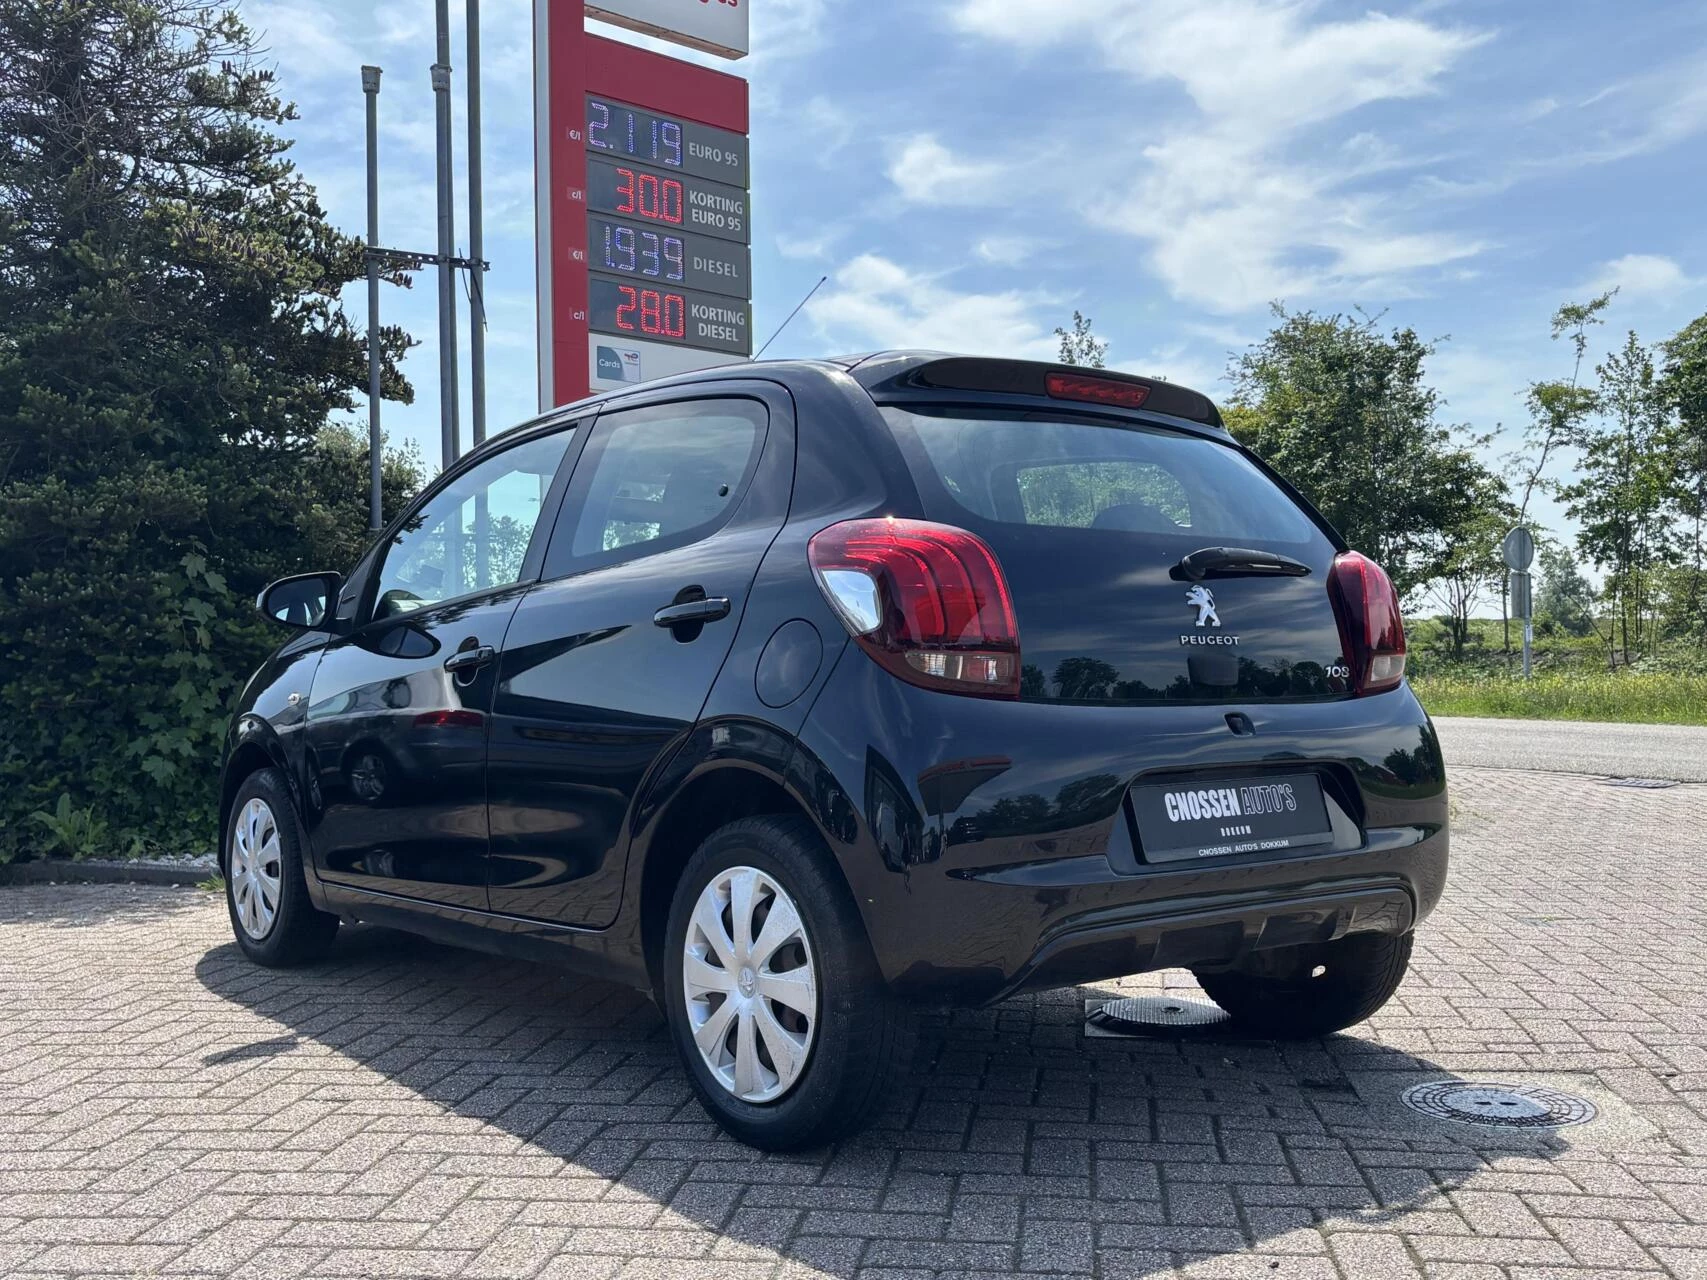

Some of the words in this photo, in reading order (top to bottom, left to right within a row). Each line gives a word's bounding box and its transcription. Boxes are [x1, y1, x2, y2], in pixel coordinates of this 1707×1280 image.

[588, 102, 681, 166] 2.119
[688, 142, 722, 162] EURO
[724, 153, 739, 167] 95
[616, 167, 682, 224] 30.0
[689, 190, 743, 215] KORTING
[691, 208, 725, 228] EURO
[727, 217, 742, 232] 95
[604, 225, 684, 281] 1.939
[693, 257, 739, 278] DIESEL
[616, 285, 684, 337] 28.0
[691, 303, 745, 326] KORTING
[697, 323, 739, 342] DIESEL
[598, 358, 621, 369] Cards
[1180, 635, 1240, 646] PEUGEOT
[1325, 666, 1350, 678] 108
[1164, 788, 1241, 823] CNOSSEN
[1240, 783, 1297, 815] AUTO'S
[1198, 846, 1232, 857] CNOSSEN
[1234, 843, 1258, 852] AUTO'S
[1260, 839, 1290, 850] DOKKUM
